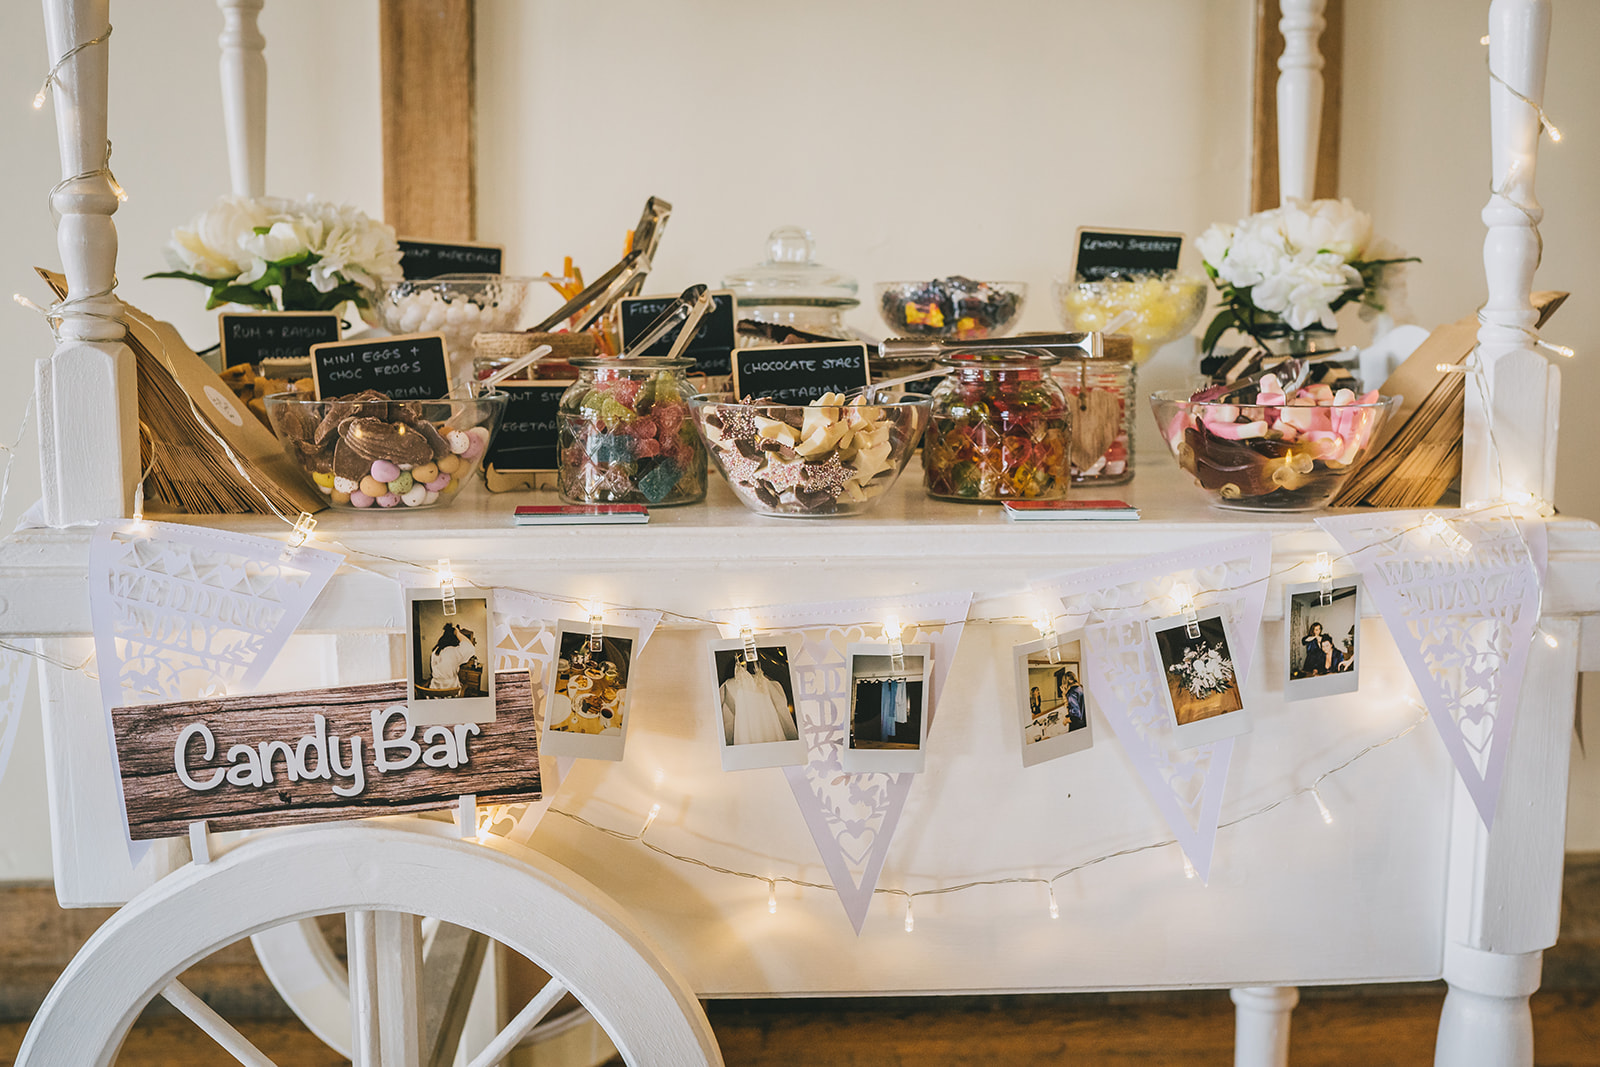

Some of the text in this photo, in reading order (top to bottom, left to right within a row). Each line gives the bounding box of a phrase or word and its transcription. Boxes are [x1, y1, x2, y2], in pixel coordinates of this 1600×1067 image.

[233, 324, 261, 339] RUM
[281, 326, 328, 338] RAISIN
[323, 346, 419, 366] MINI EGGS +
[822, 357, 860, 369] STARS
[329, 361, 421, 380] CHOC FROGS
[174, 705, 481, 797] Candy Bar
